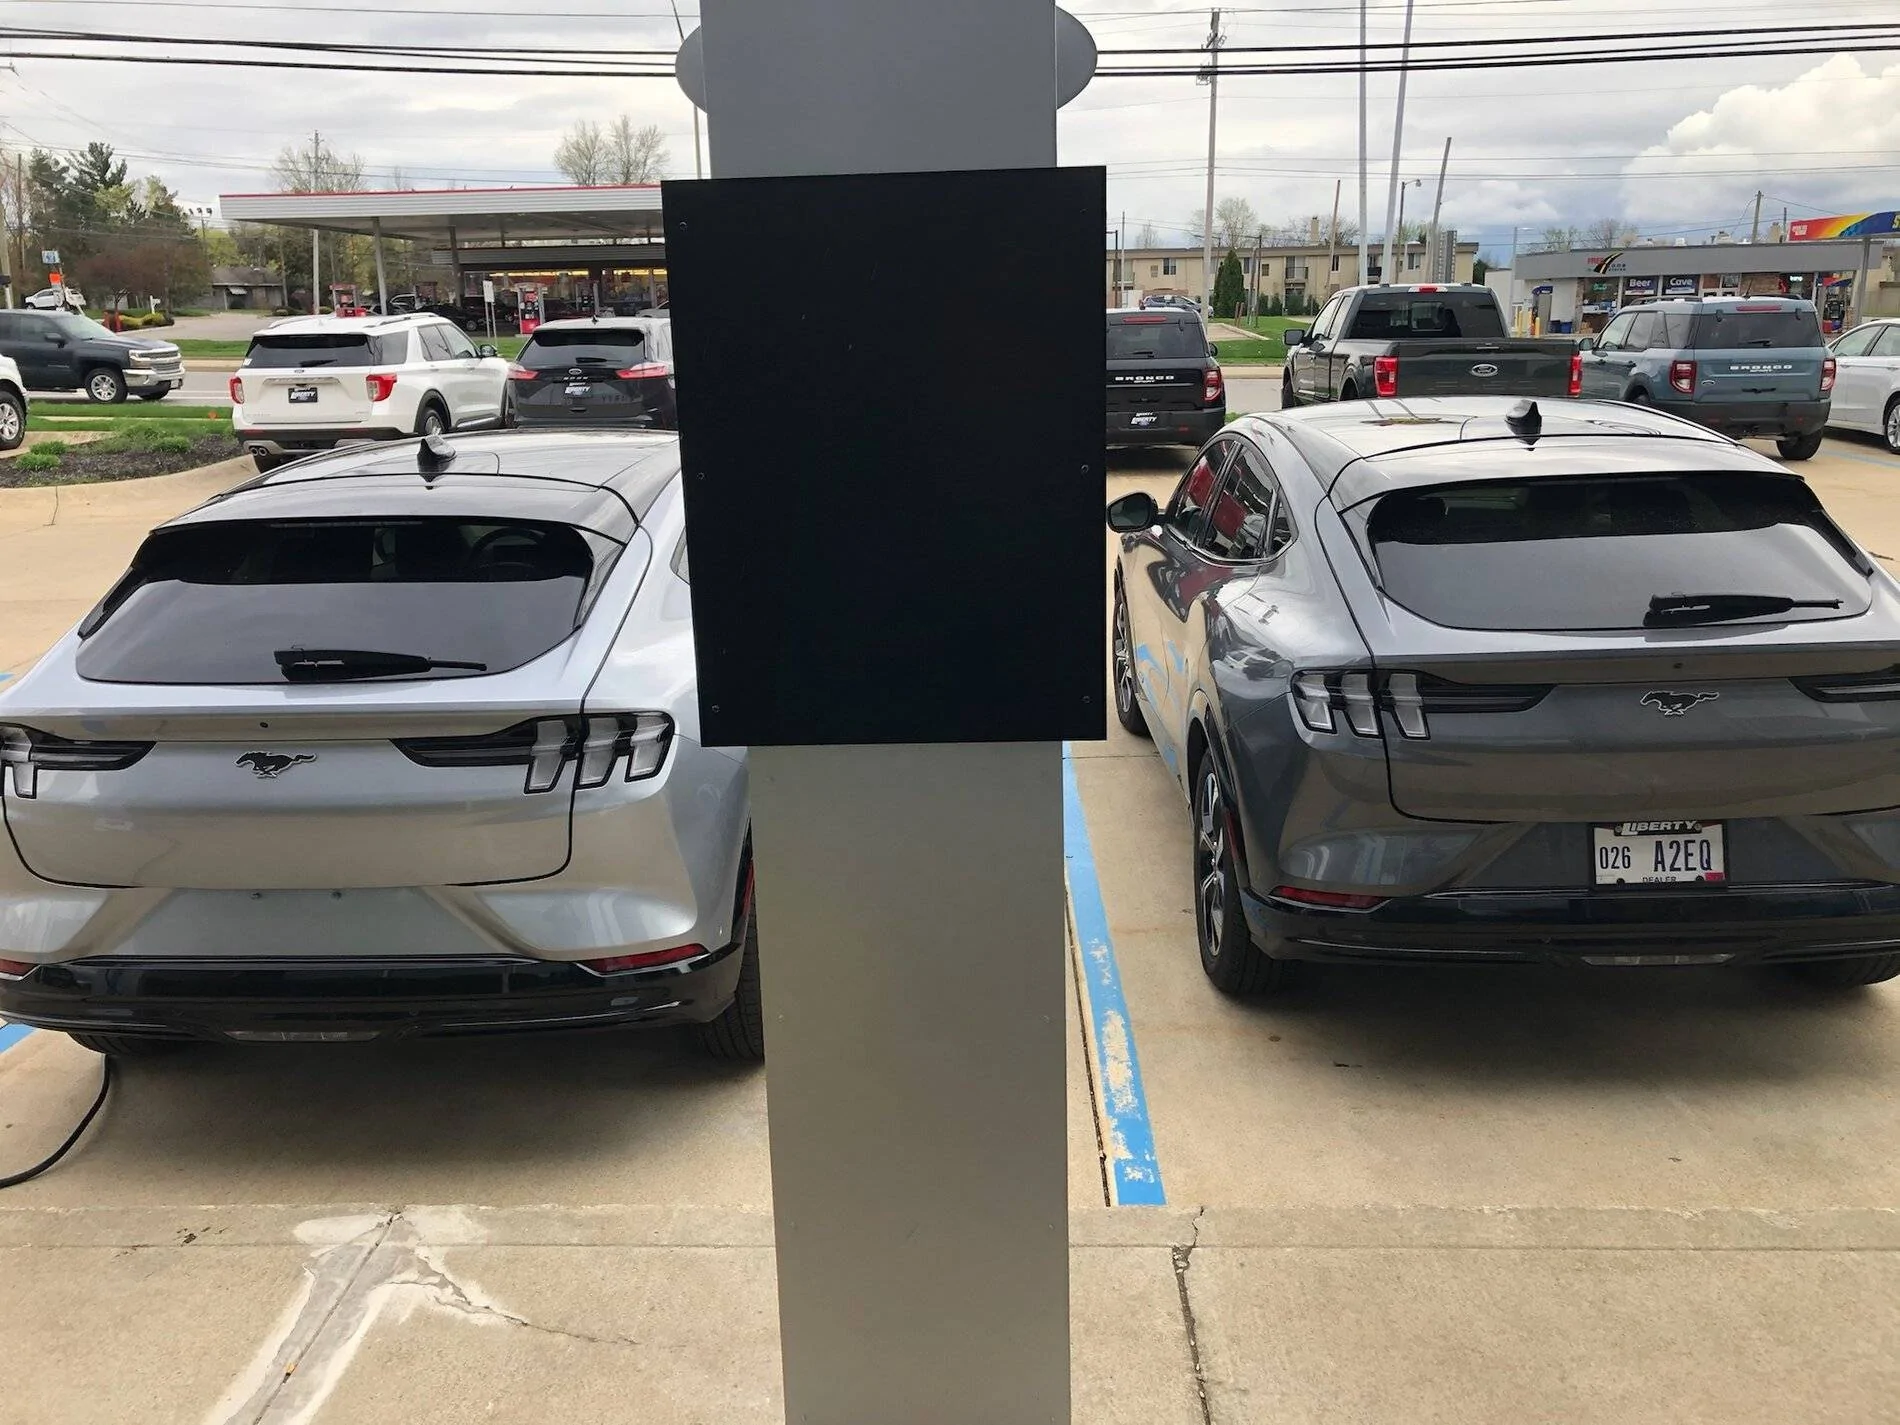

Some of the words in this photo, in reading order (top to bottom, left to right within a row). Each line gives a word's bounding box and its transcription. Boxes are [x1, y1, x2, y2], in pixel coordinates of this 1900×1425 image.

[1629, 279, 1652, 287] Beer
[1670, 277, 1693, 286] Cave
[1621, 820, 1697, 836] LIBERTY
[1600, 846, 1631, 869] 026
[1653, 839, 1712, 872] A2EQ
